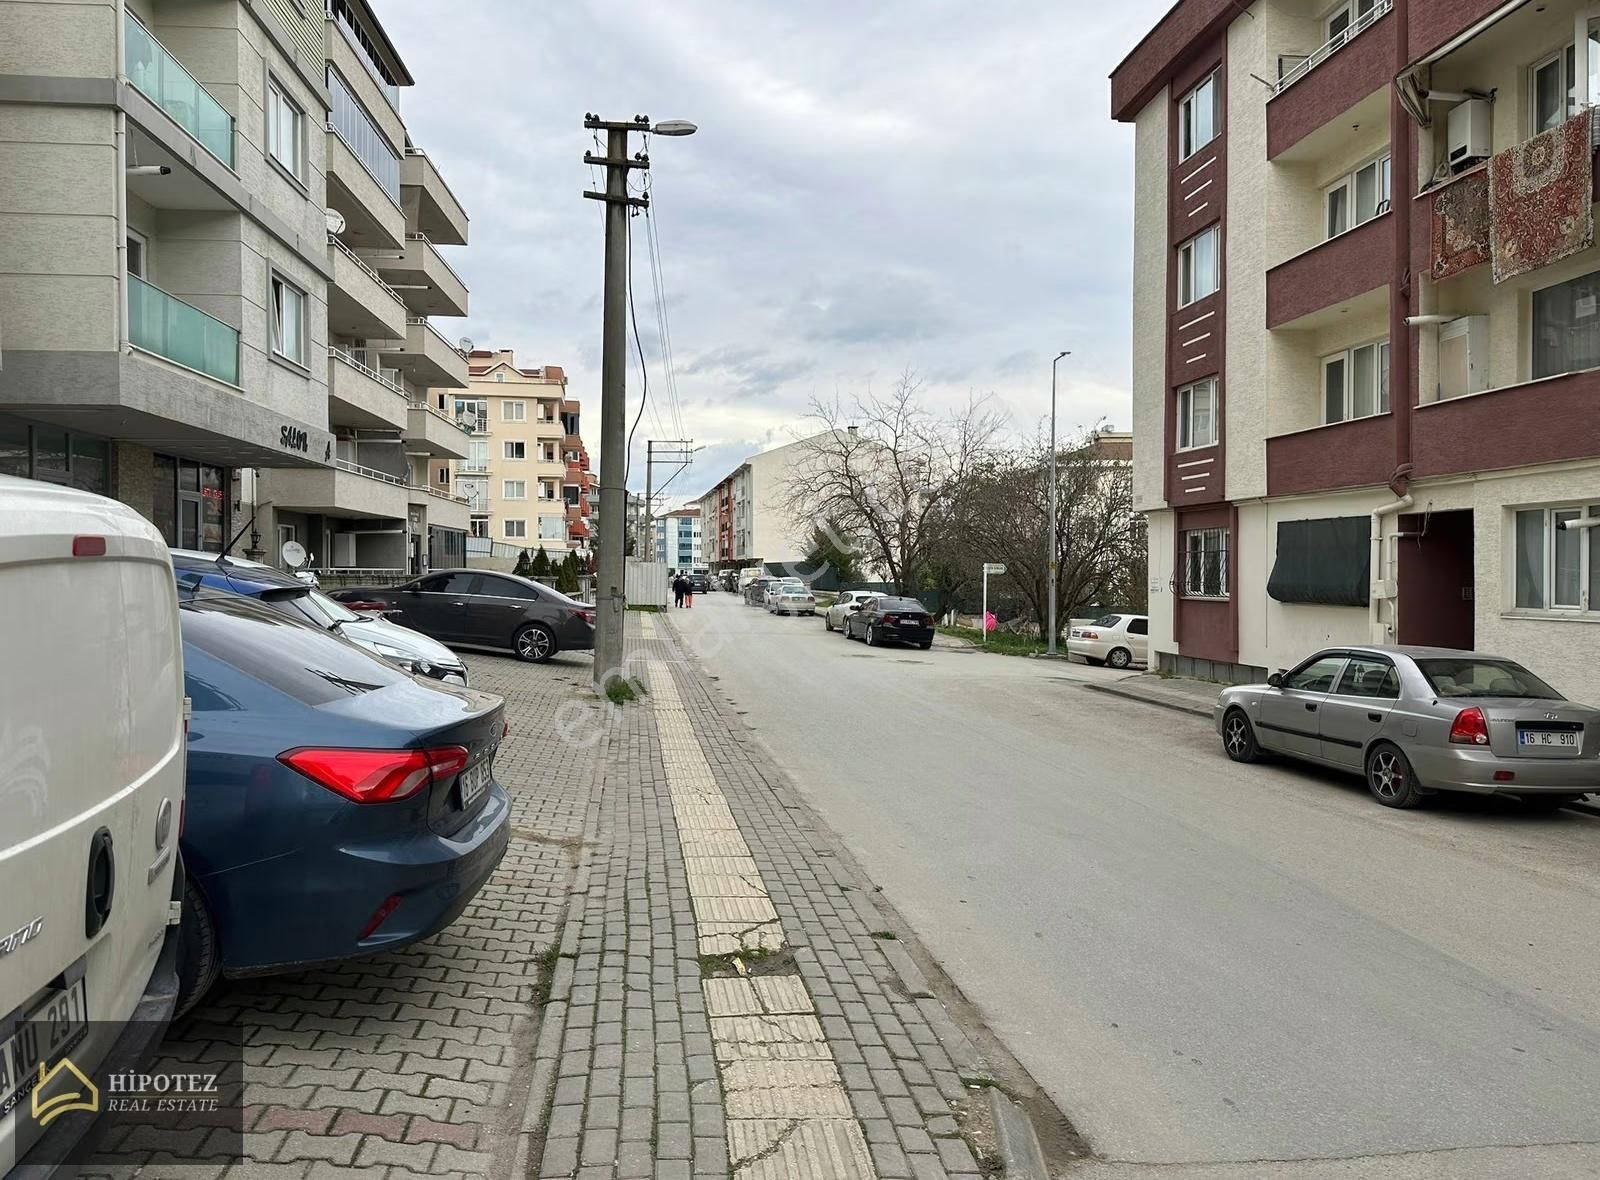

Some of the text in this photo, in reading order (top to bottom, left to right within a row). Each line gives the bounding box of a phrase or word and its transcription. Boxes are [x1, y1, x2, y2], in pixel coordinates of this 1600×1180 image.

[1526, 733, 1575, 745] 16 HC 910
[48, 986, 80, 1050] 291
